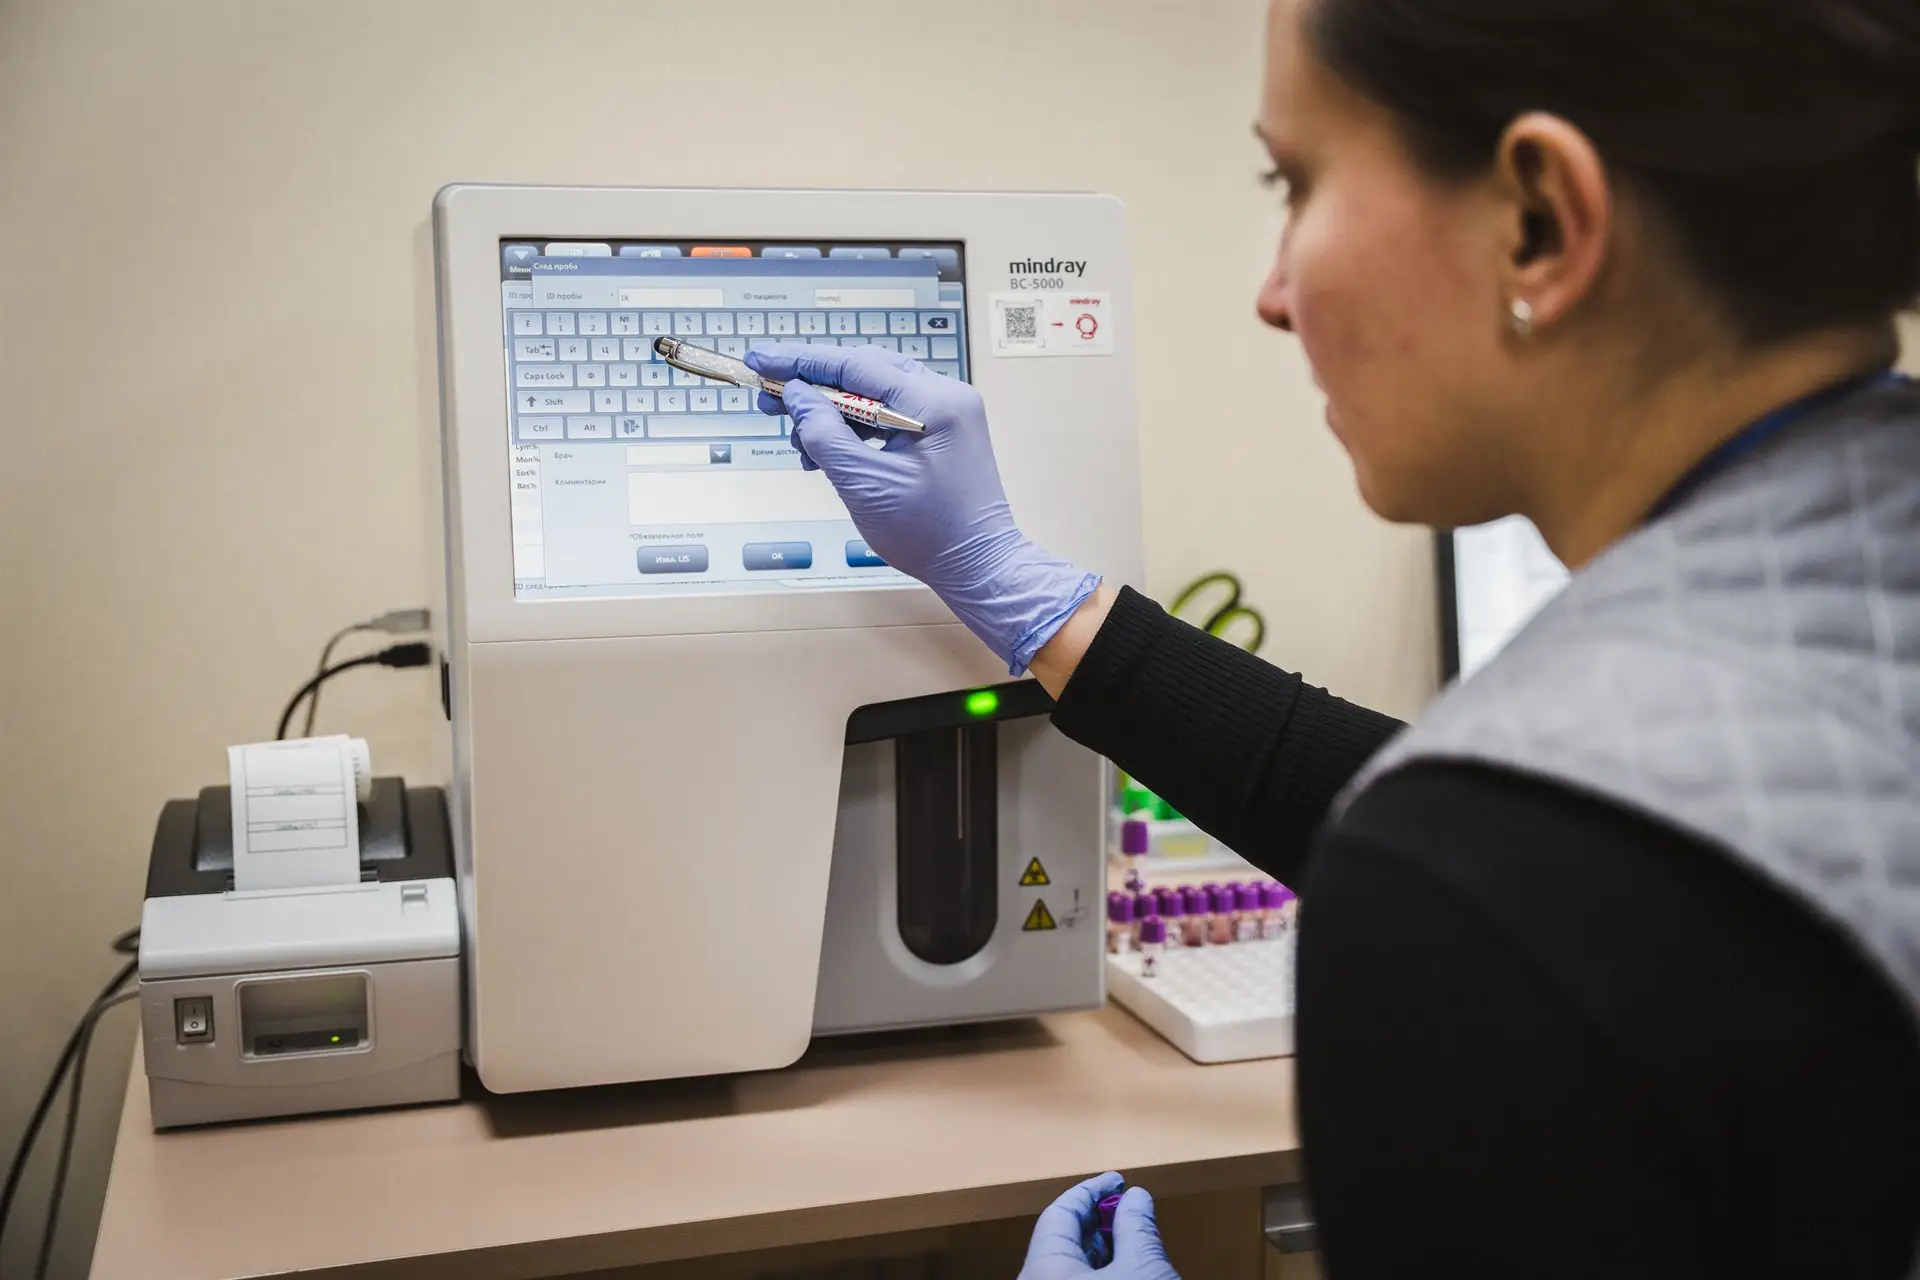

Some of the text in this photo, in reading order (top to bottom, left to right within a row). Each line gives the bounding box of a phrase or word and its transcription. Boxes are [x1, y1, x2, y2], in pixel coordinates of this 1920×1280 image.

[554, 263, 578, 271] проба
[1010, 258, 1087, 277] mindray
[1010, 278, 1064, 289] BC-5000
[557, 292, 582, 300] пробы
[1069, 298, 1101, 307] mindray
[533, 424, 549, 432] Ctrl
